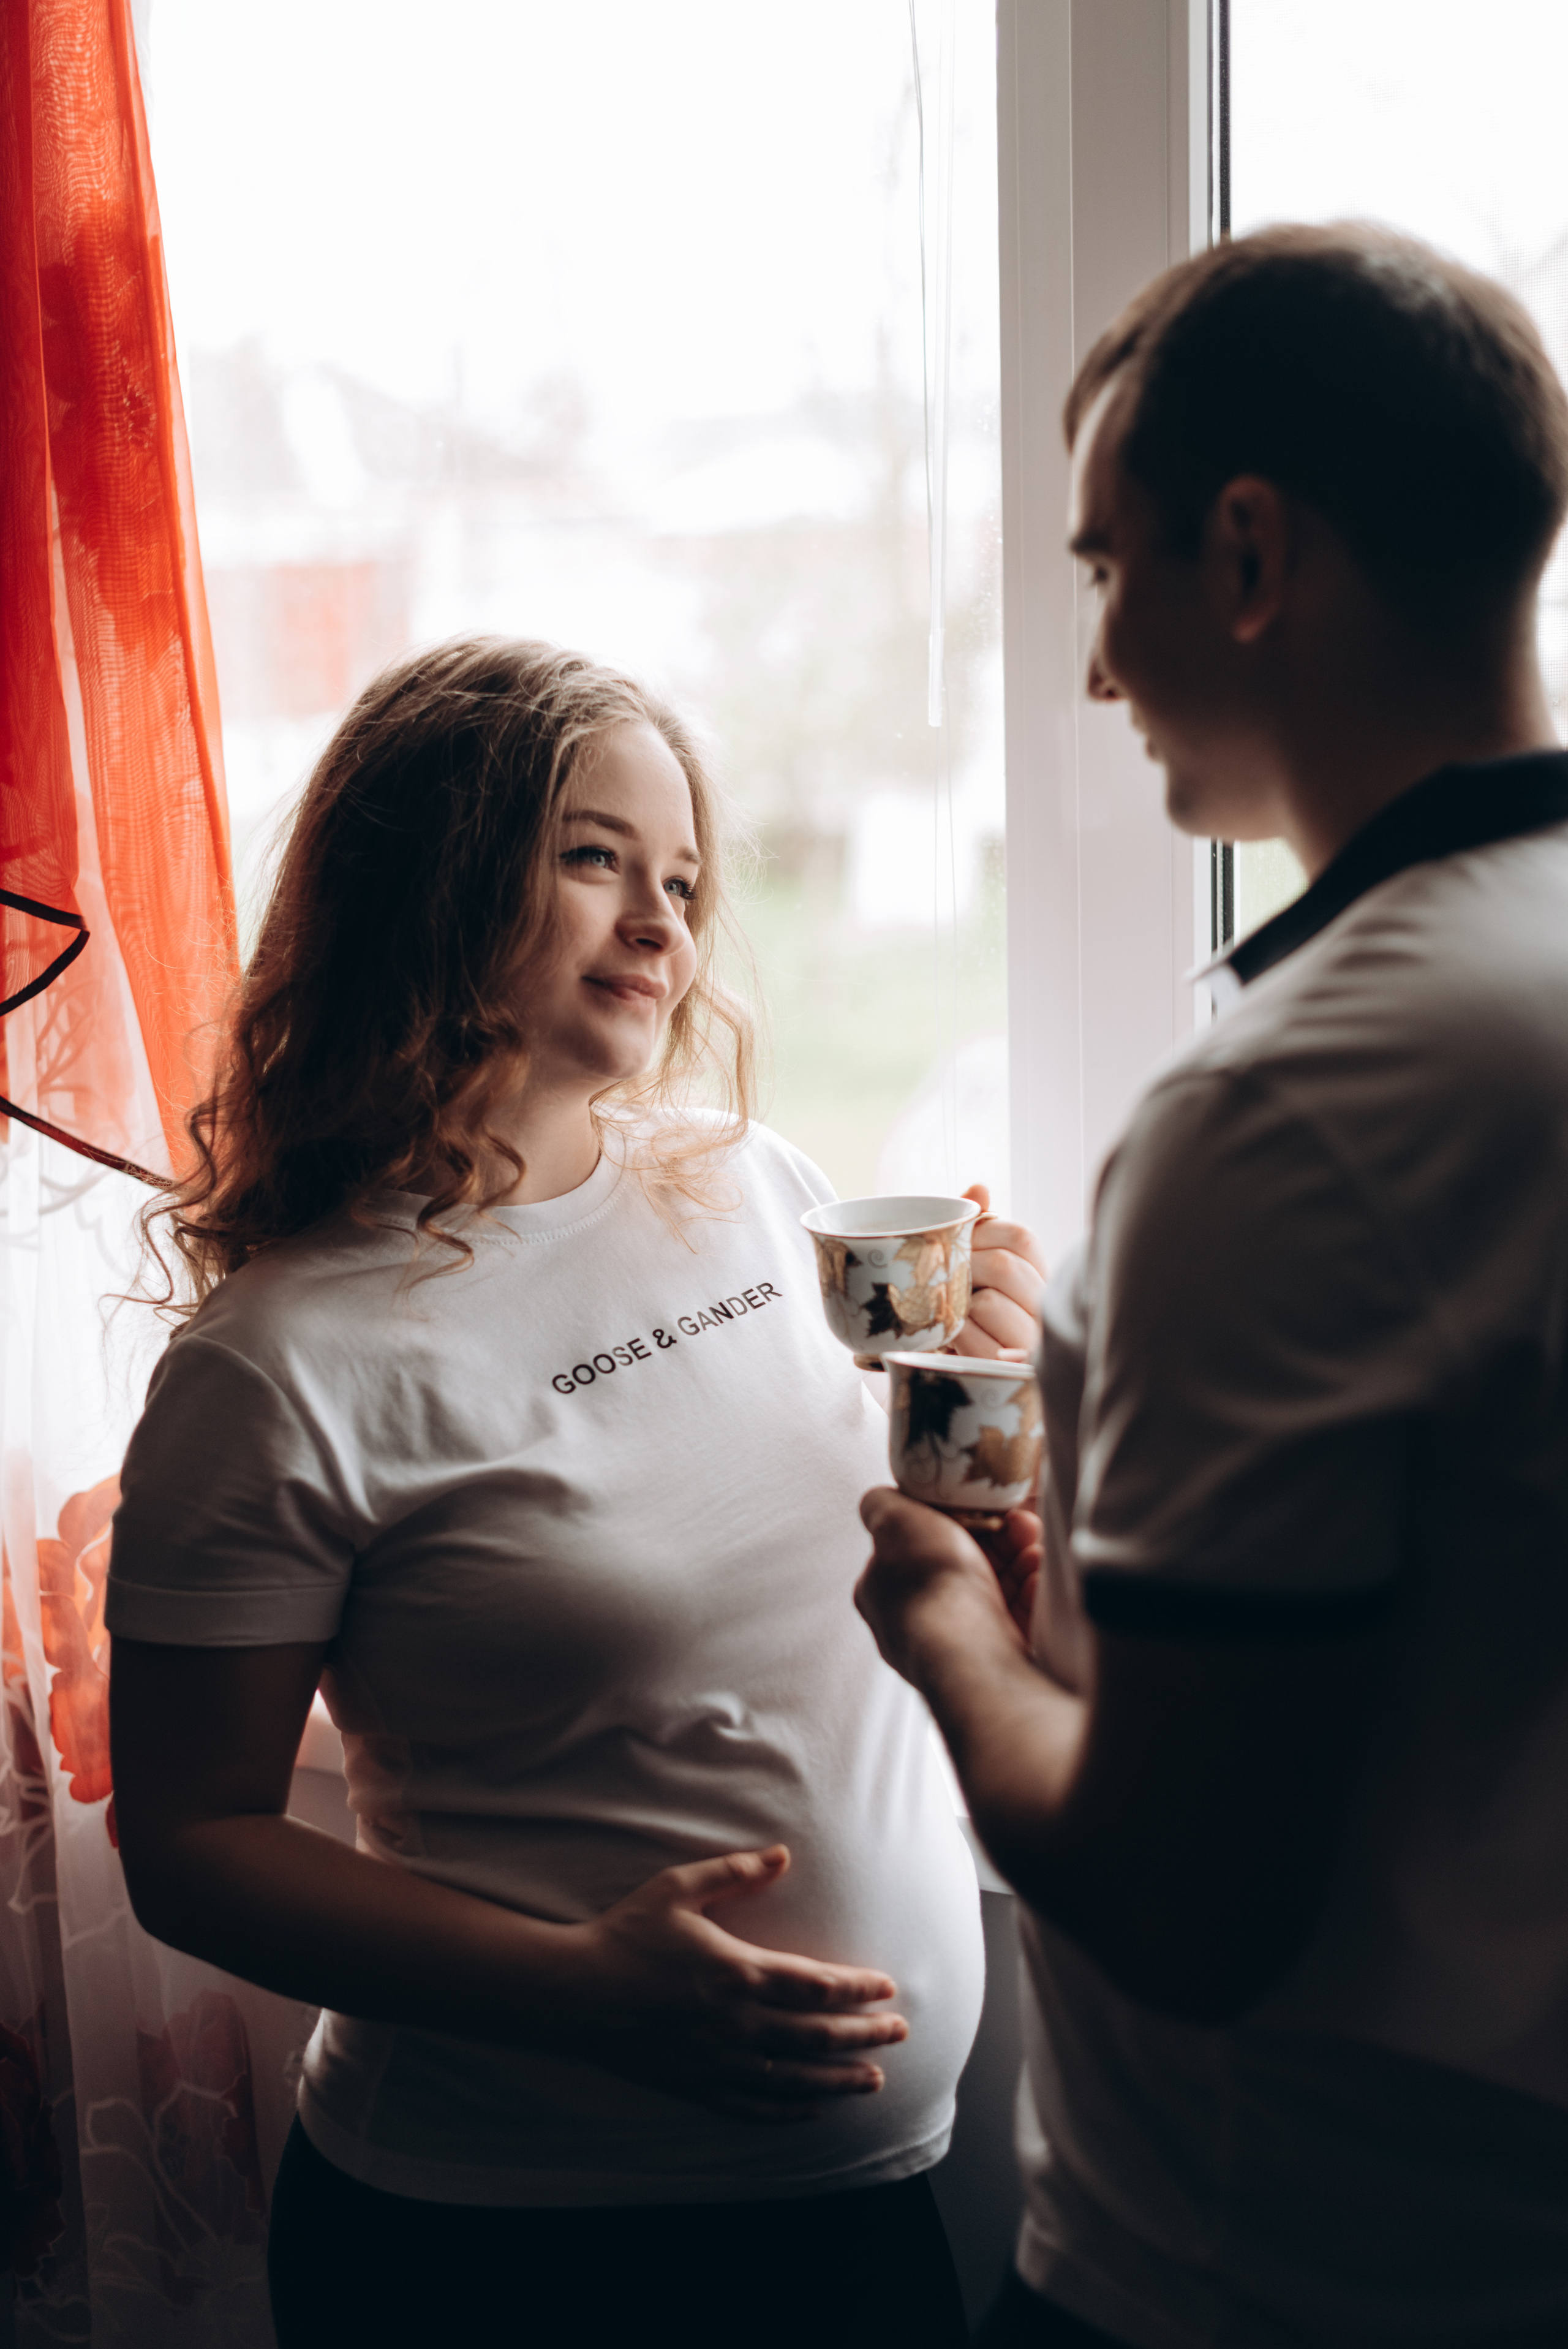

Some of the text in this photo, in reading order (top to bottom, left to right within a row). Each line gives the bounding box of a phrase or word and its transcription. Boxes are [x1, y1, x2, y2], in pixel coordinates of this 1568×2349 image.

[552, 1282, 783, 1394] GOOSE & GANDER
